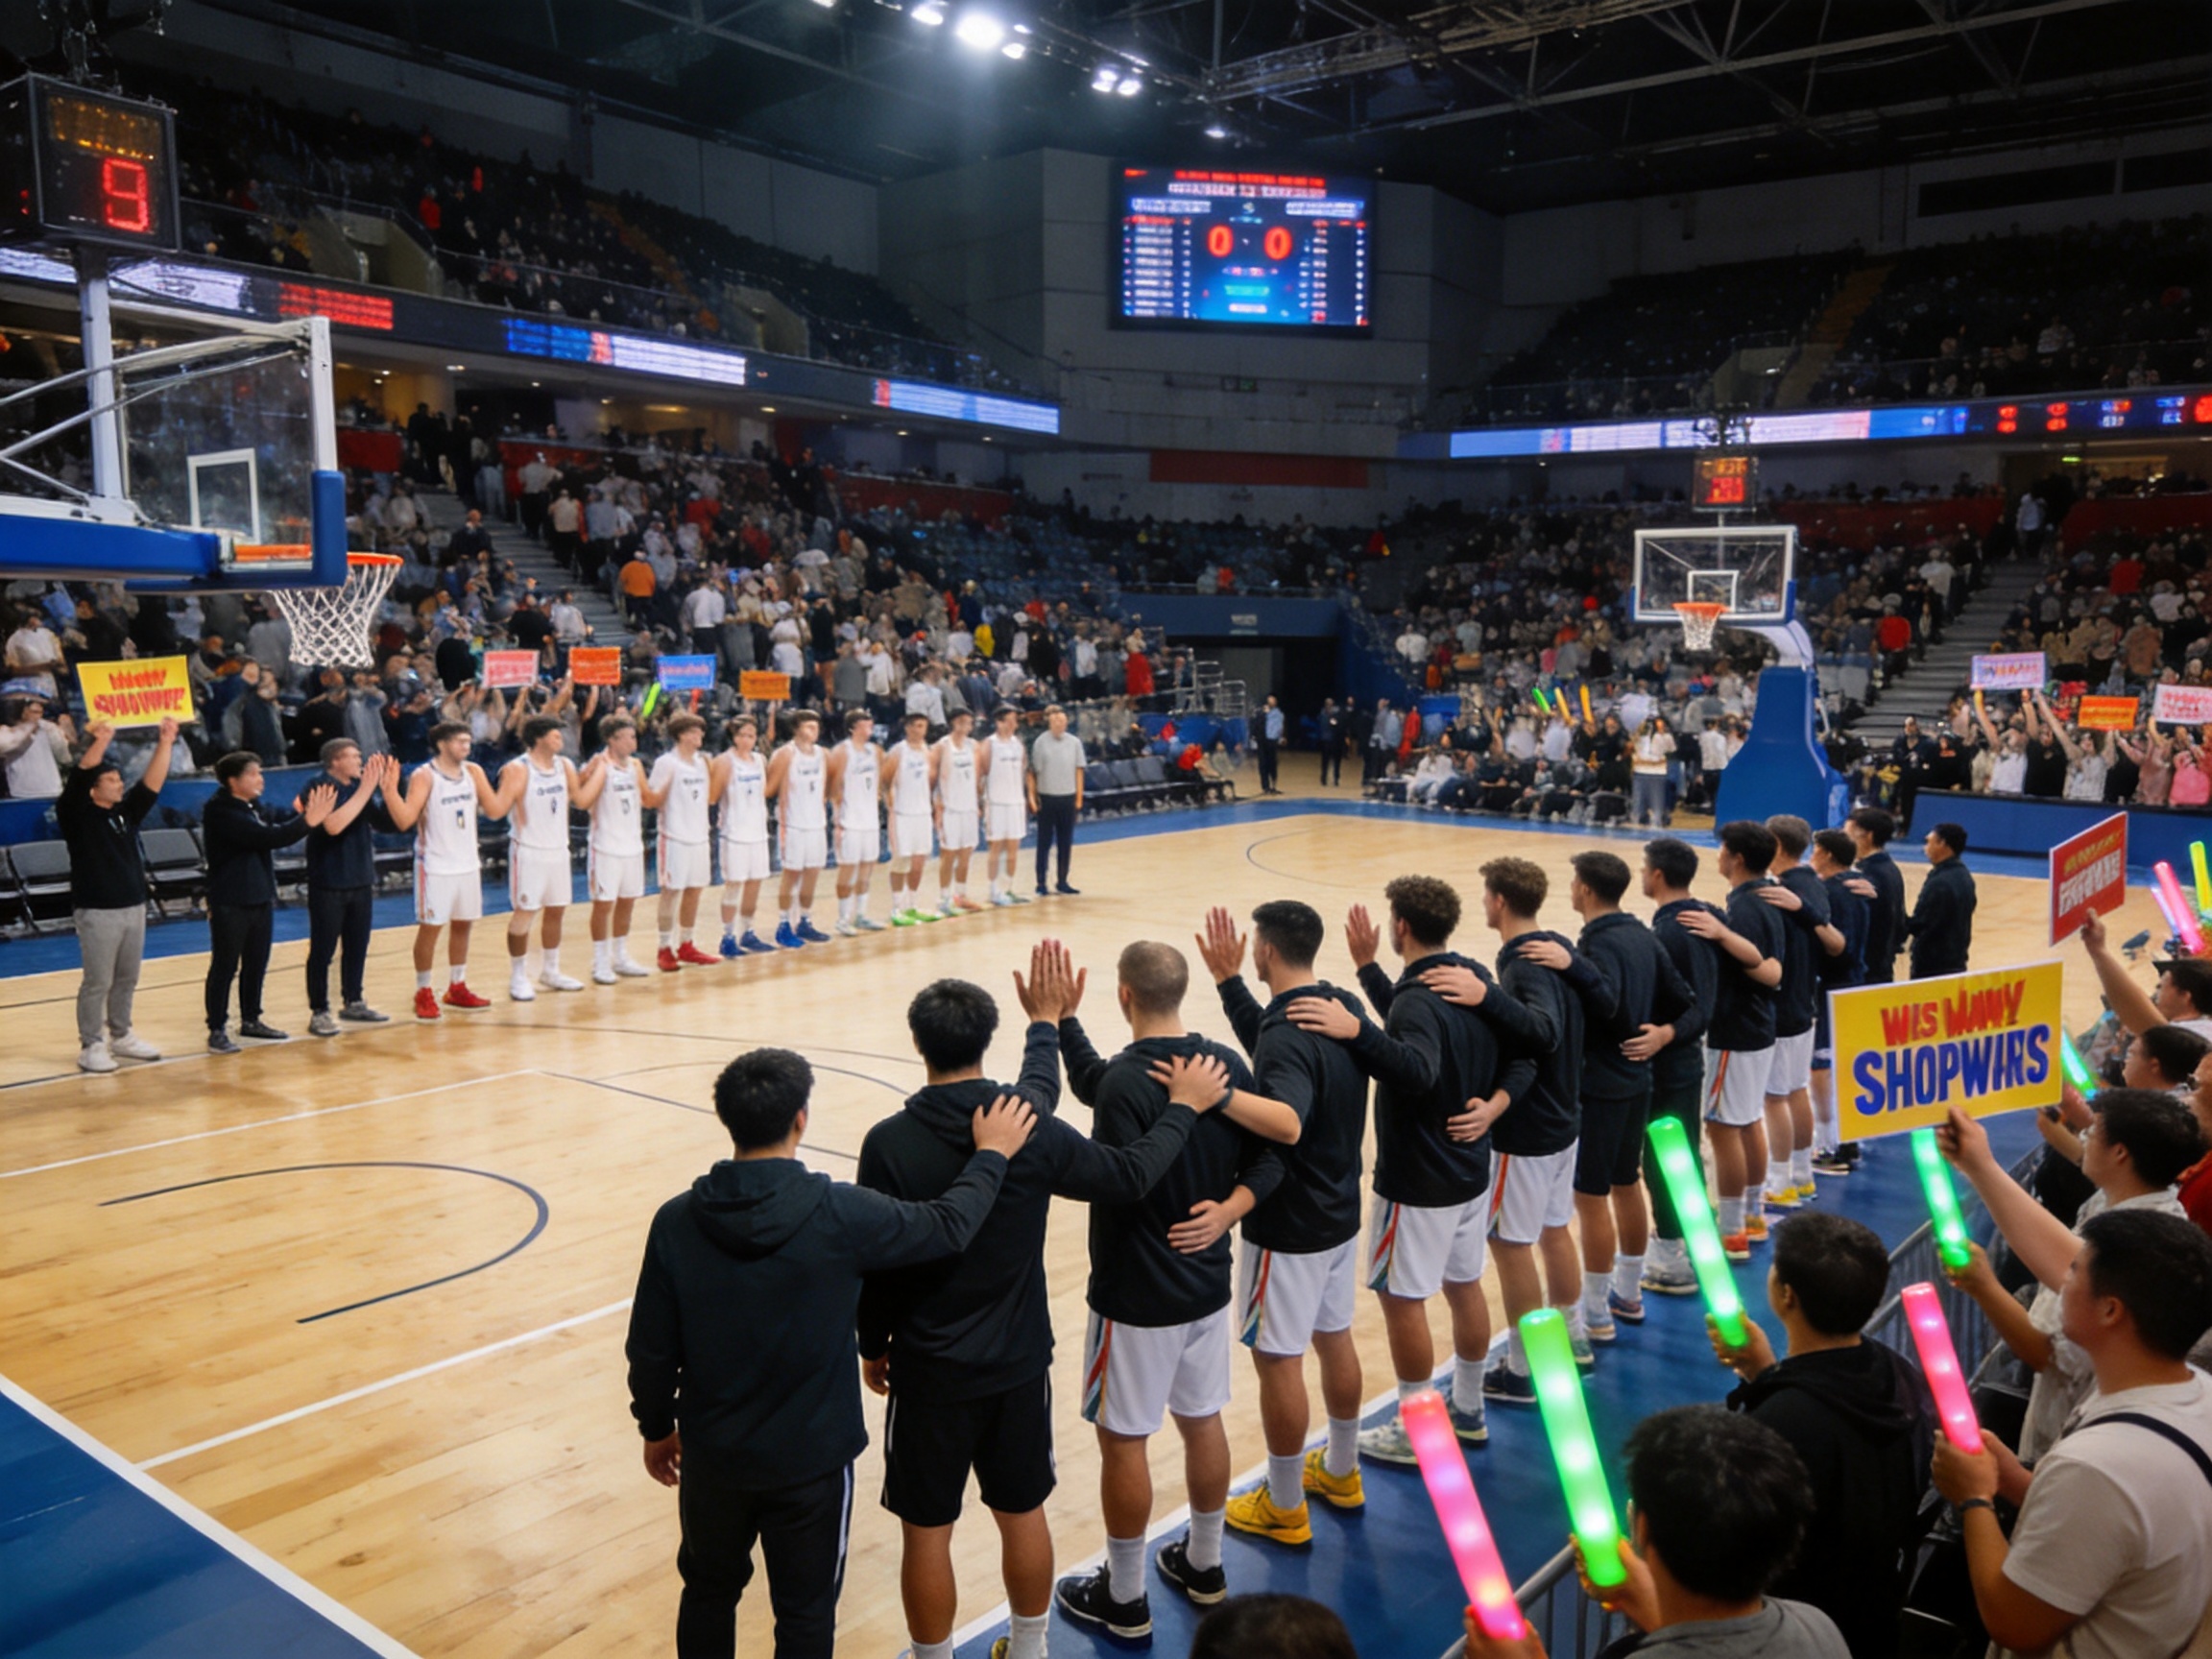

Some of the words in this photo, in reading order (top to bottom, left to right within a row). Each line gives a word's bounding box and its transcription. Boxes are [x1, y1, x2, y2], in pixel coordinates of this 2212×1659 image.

[1209, 225, 1233, 257] 0
[1264, 227, 1291, 259] 0
[1880, 1001, 1938, 1046] WIS
